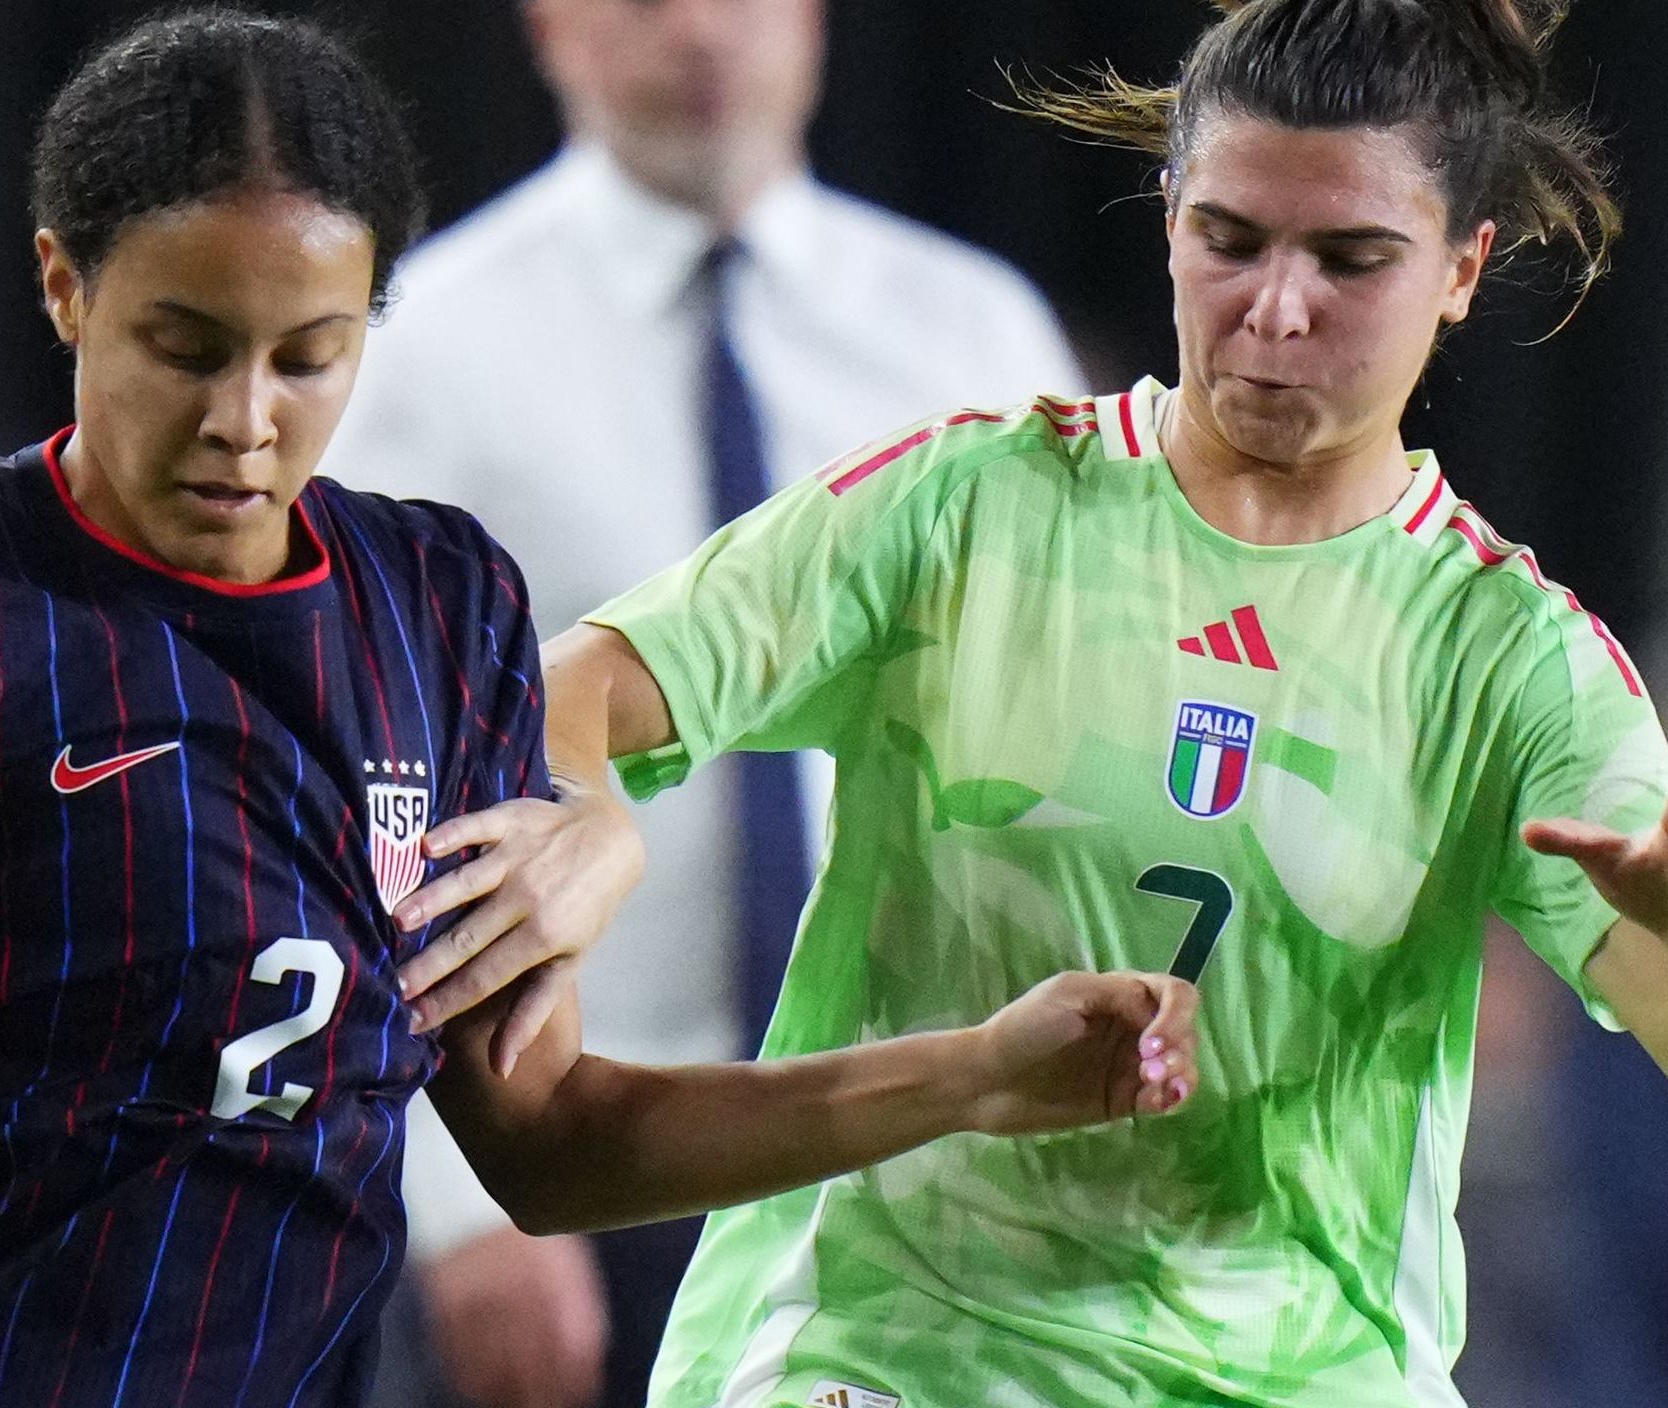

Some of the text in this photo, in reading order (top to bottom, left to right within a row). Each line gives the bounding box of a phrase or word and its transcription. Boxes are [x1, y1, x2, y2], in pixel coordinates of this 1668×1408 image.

[1180, 706, 1249, 740] ITALIA
[374, 792, 424, 841] USA
[1135, 863, 1233, 985] 7
[210, 937, 345, 1122] 2
